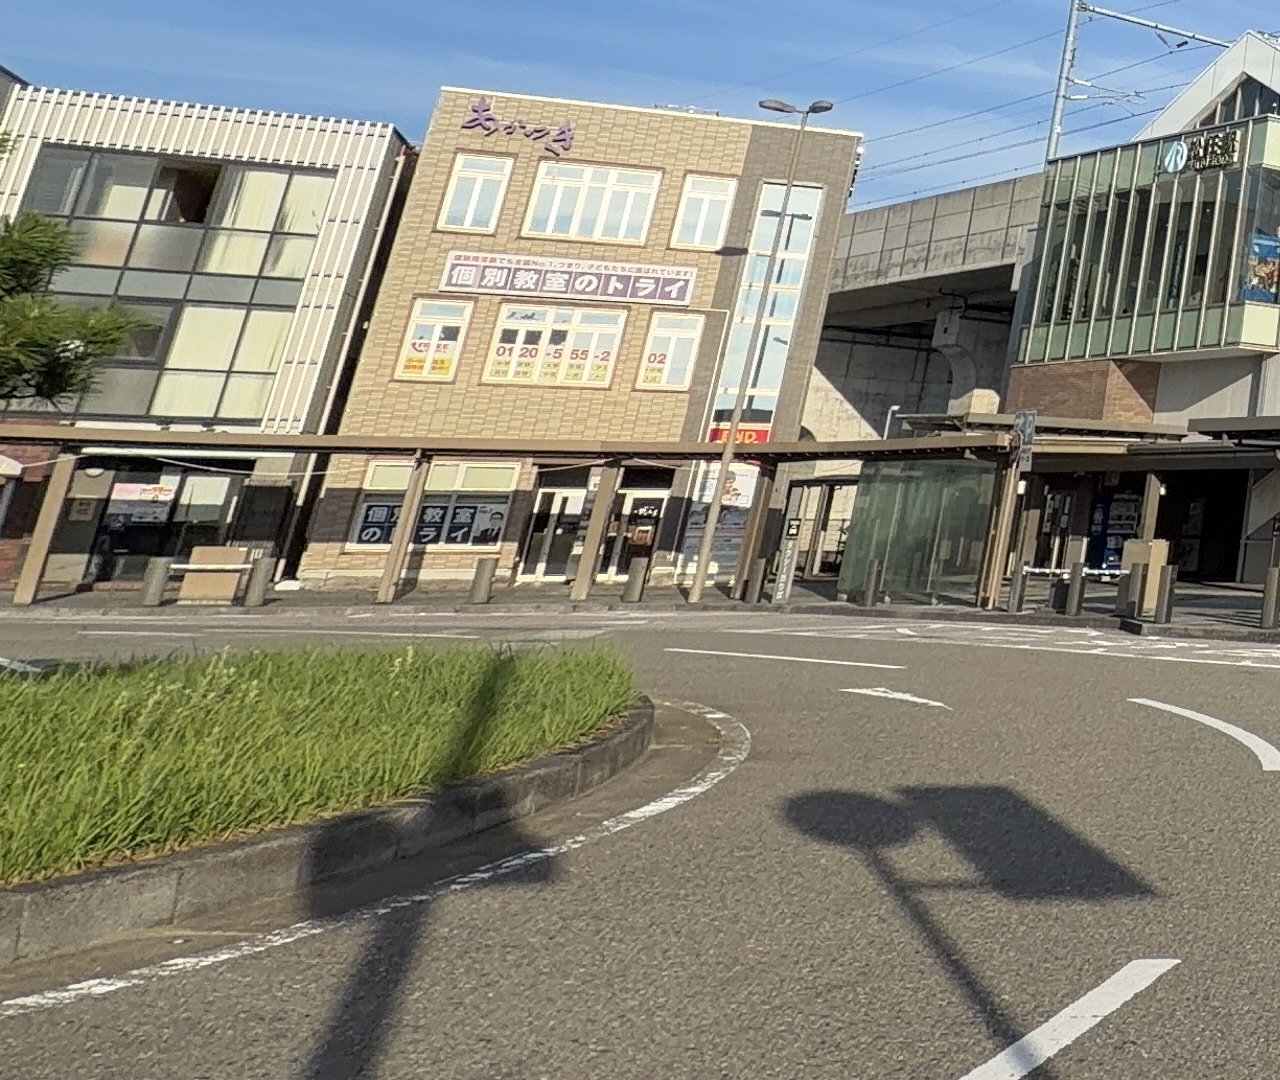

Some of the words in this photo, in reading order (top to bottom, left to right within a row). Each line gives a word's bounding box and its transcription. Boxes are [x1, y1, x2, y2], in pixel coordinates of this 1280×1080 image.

[451, 265, 685, 298] 個別教室のトライ
